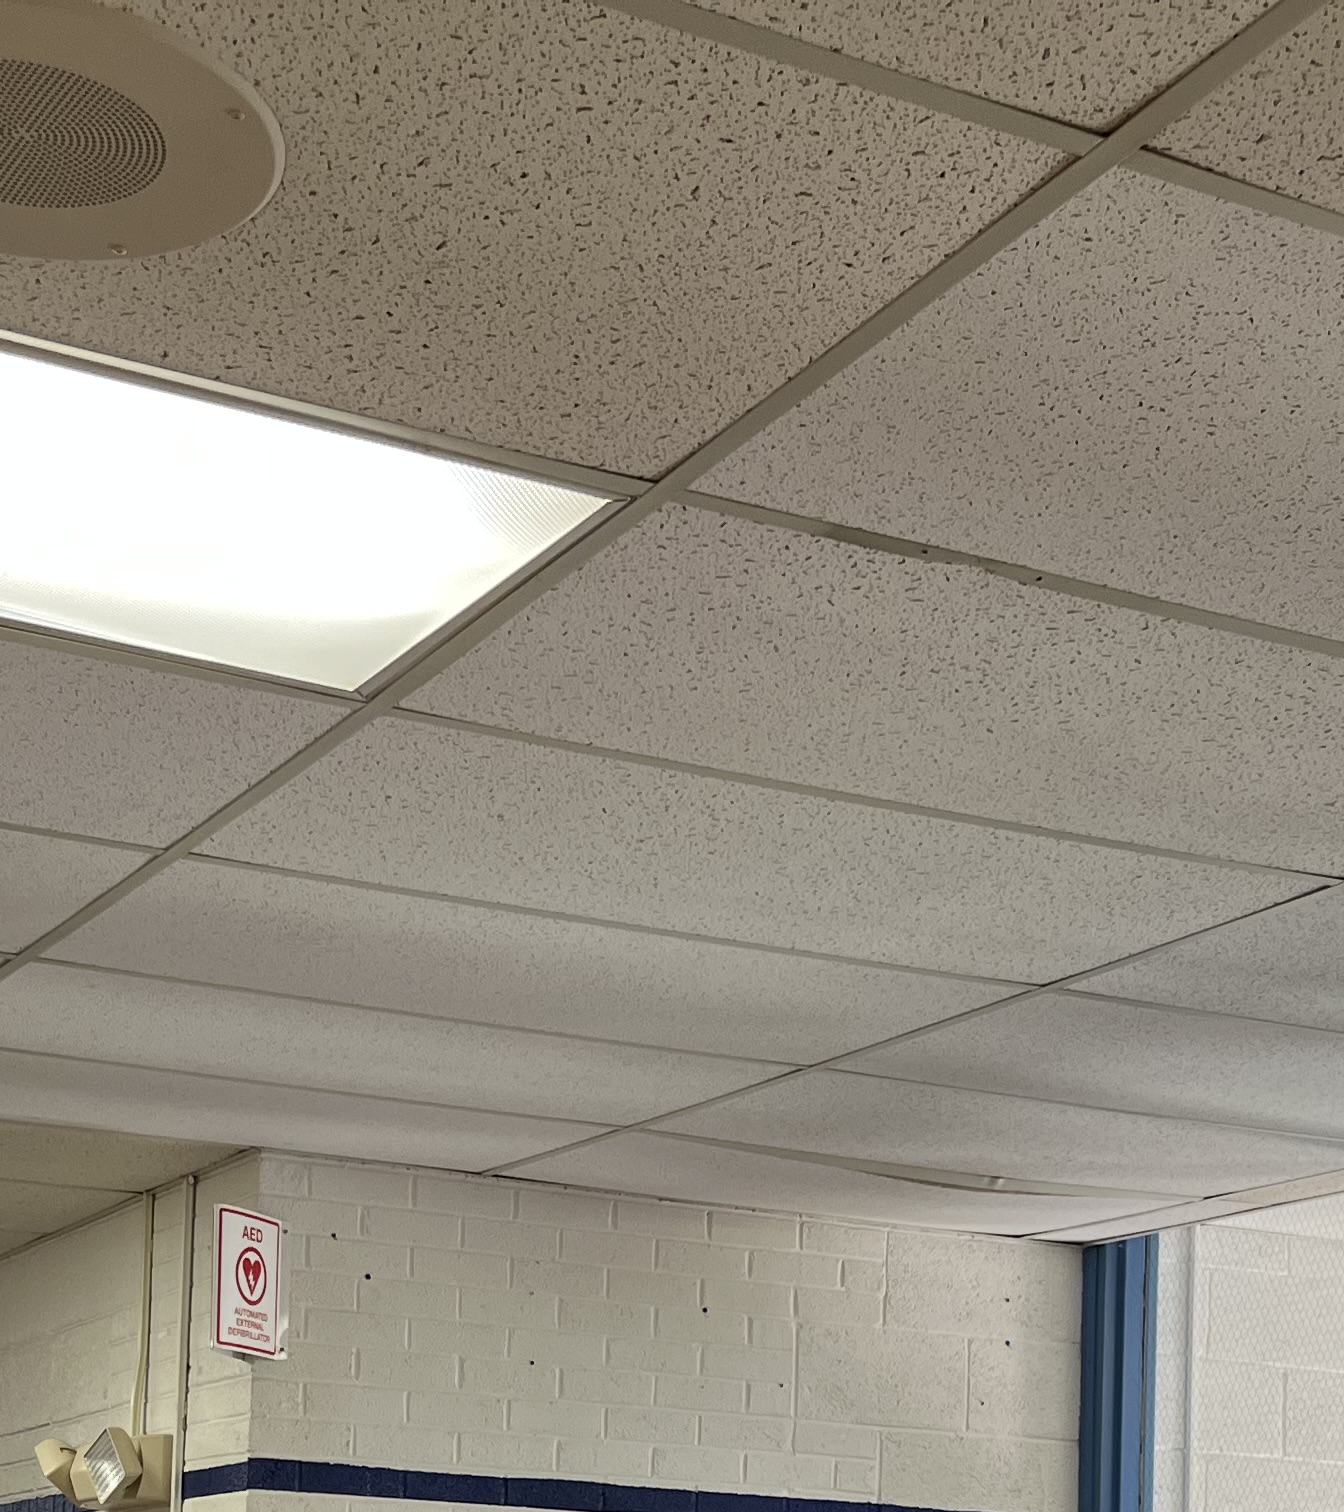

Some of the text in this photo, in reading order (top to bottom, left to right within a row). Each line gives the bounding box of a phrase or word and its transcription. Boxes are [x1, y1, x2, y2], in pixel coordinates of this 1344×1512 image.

[242, 1225, 263, 1244] AED
[234, 1307, 268, 1322] AUTOMATED
[236, 1317, 264, 1331] EXTERNAL
[228, 1327, 270, 1343] DEFIBRILLATOR
